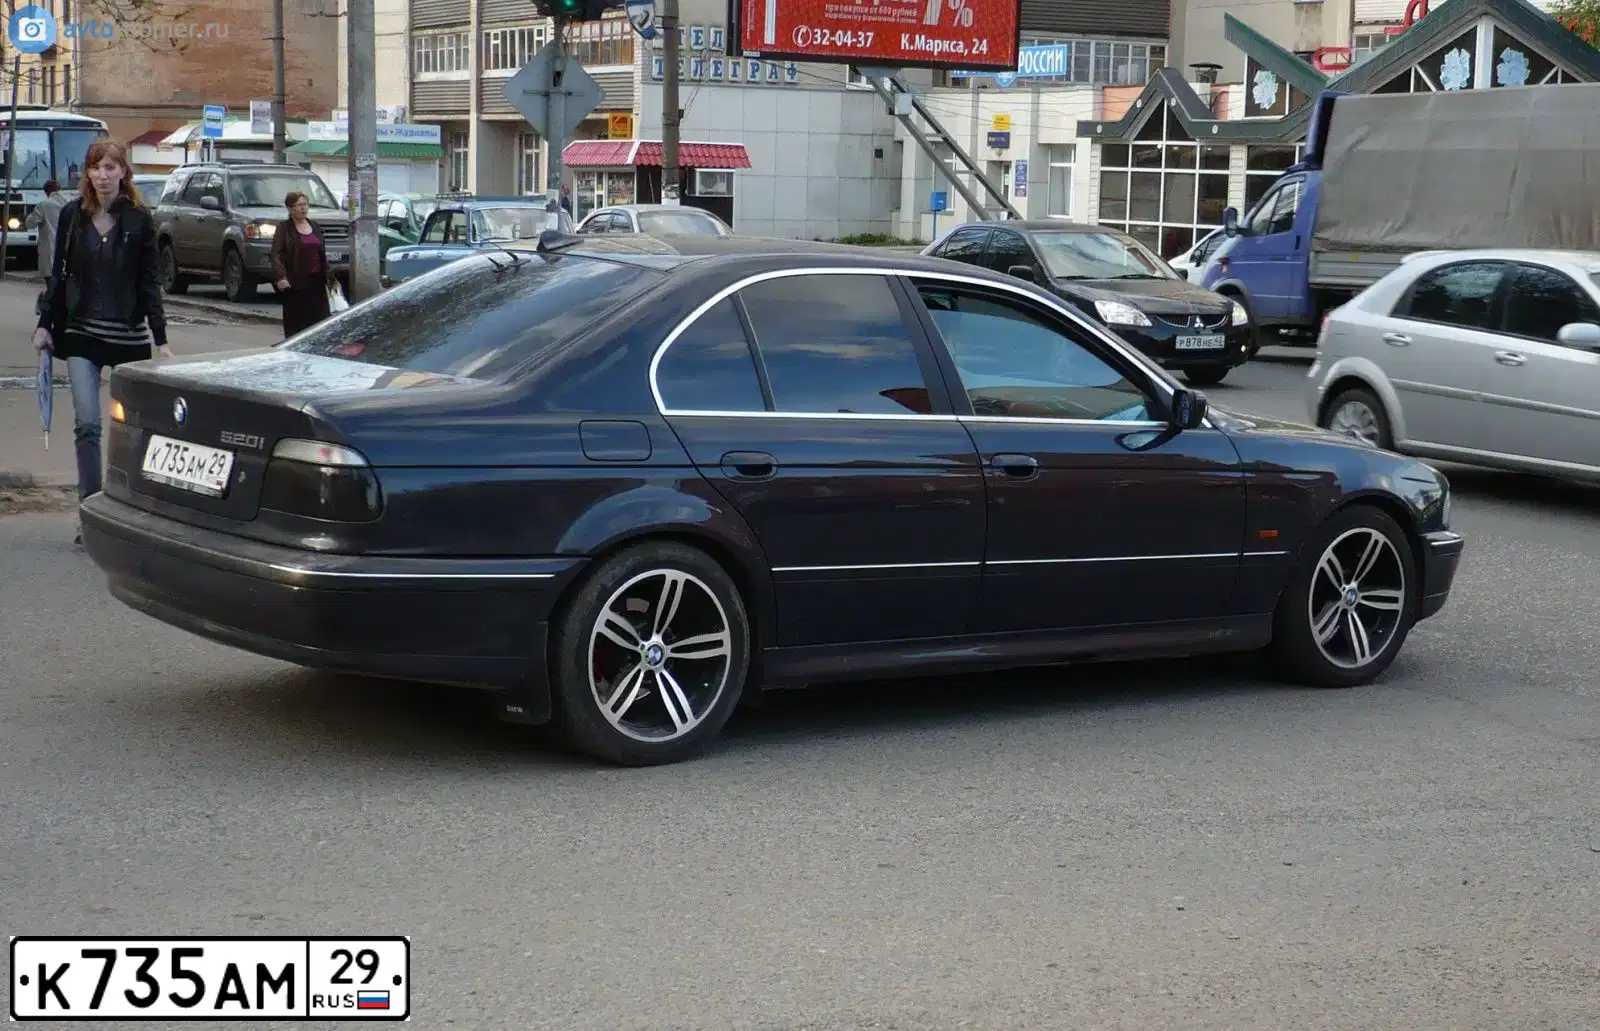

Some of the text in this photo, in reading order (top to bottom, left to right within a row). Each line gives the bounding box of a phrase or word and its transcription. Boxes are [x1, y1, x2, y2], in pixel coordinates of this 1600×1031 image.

[812, 28, 874, 48] 32-04-37
[901, 34, 988, 56] К.Маркса, 24
[654, 59, 797, 80] ТЕЛЕГРАФ
[1017, 48, 1065, 74] РОССИИ
[148, 441, 227, 480] К735АМ 29
